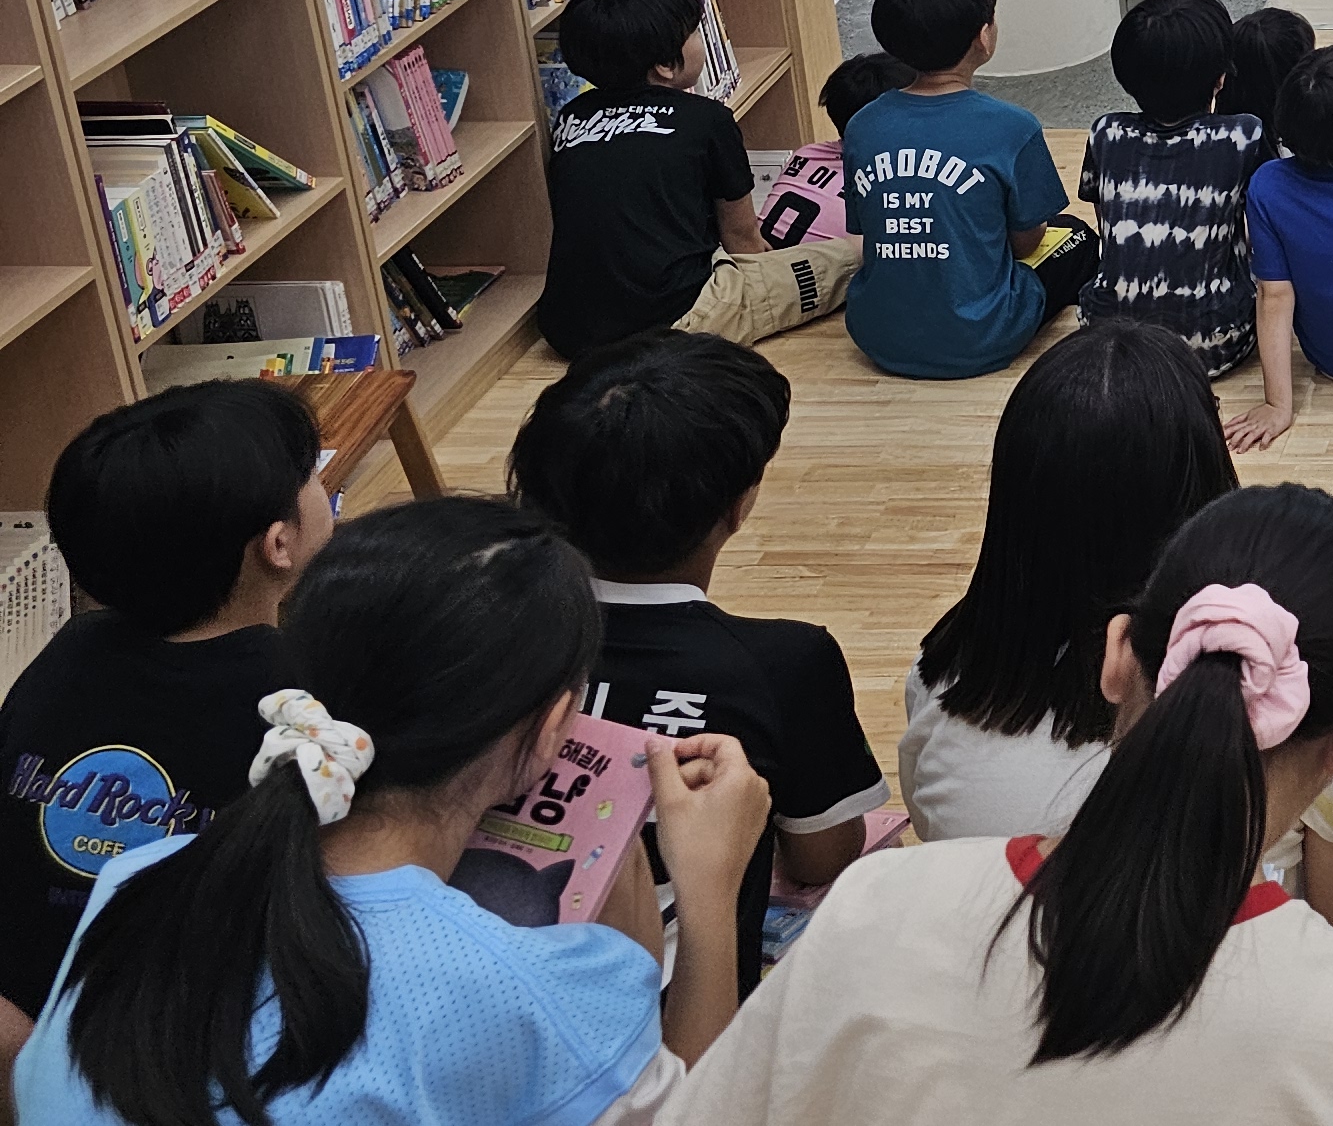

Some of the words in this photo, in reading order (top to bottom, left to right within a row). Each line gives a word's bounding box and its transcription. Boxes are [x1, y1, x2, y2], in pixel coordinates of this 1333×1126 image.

[883, 192, 900, 208] IS
[905, 192, 934, 208] MY
[885, 218, 934, 234] BEST
[876, 243, 950, 259] FRIENDS
[790, 259, 818, 314] PUMA
[558, 737, 612, 778] 해결사
[9, 752, 100, 812] Hard
